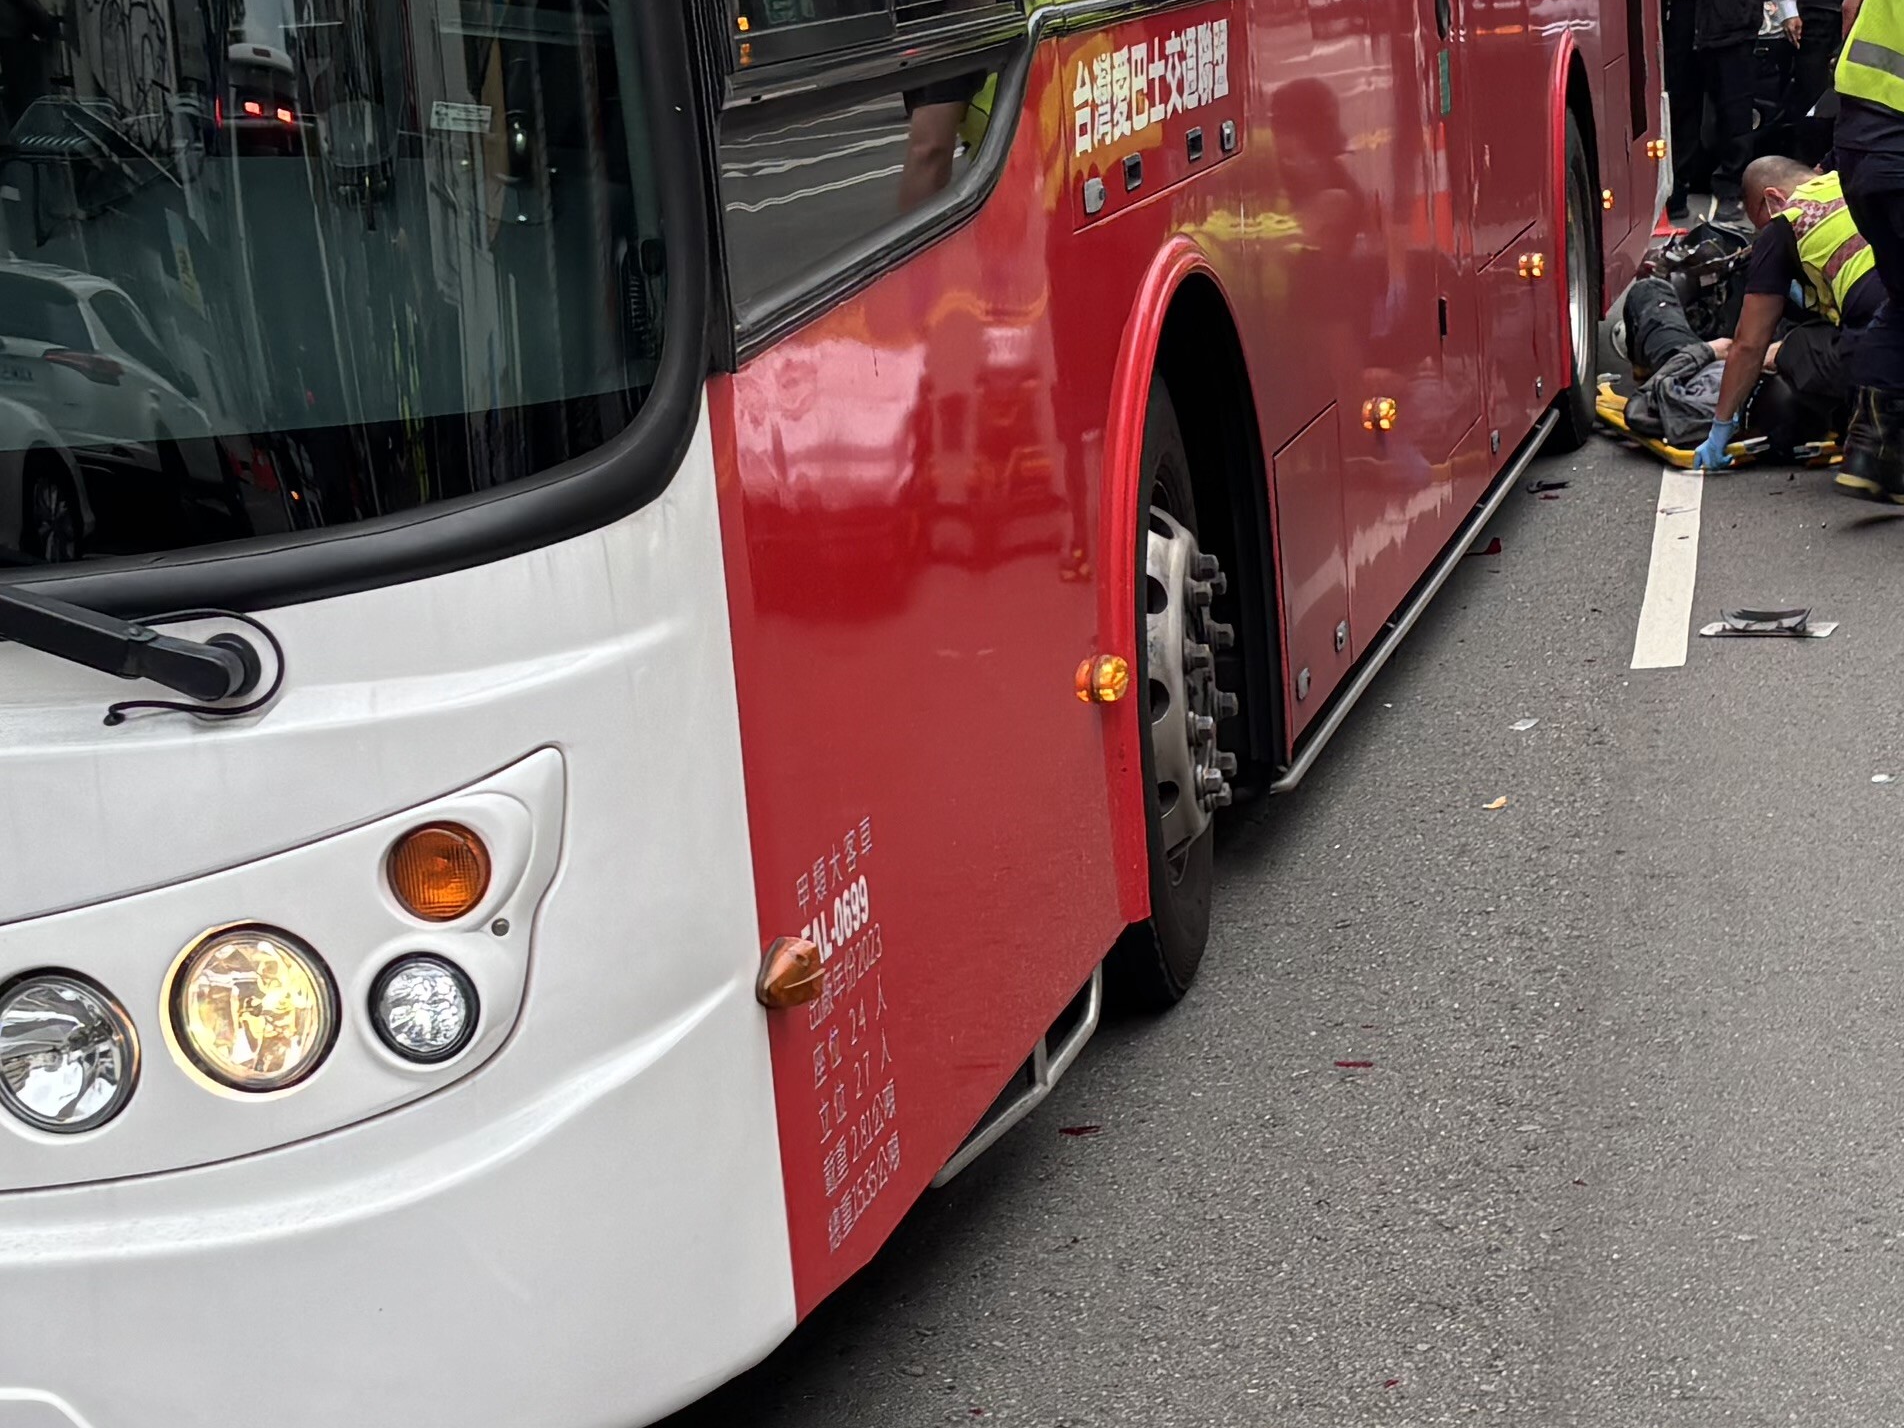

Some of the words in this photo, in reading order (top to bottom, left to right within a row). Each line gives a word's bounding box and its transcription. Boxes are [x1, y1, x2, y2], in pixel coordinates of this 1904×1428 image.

[1073, 19, 1228, 157] 台灣愛巴士交通聯盟
